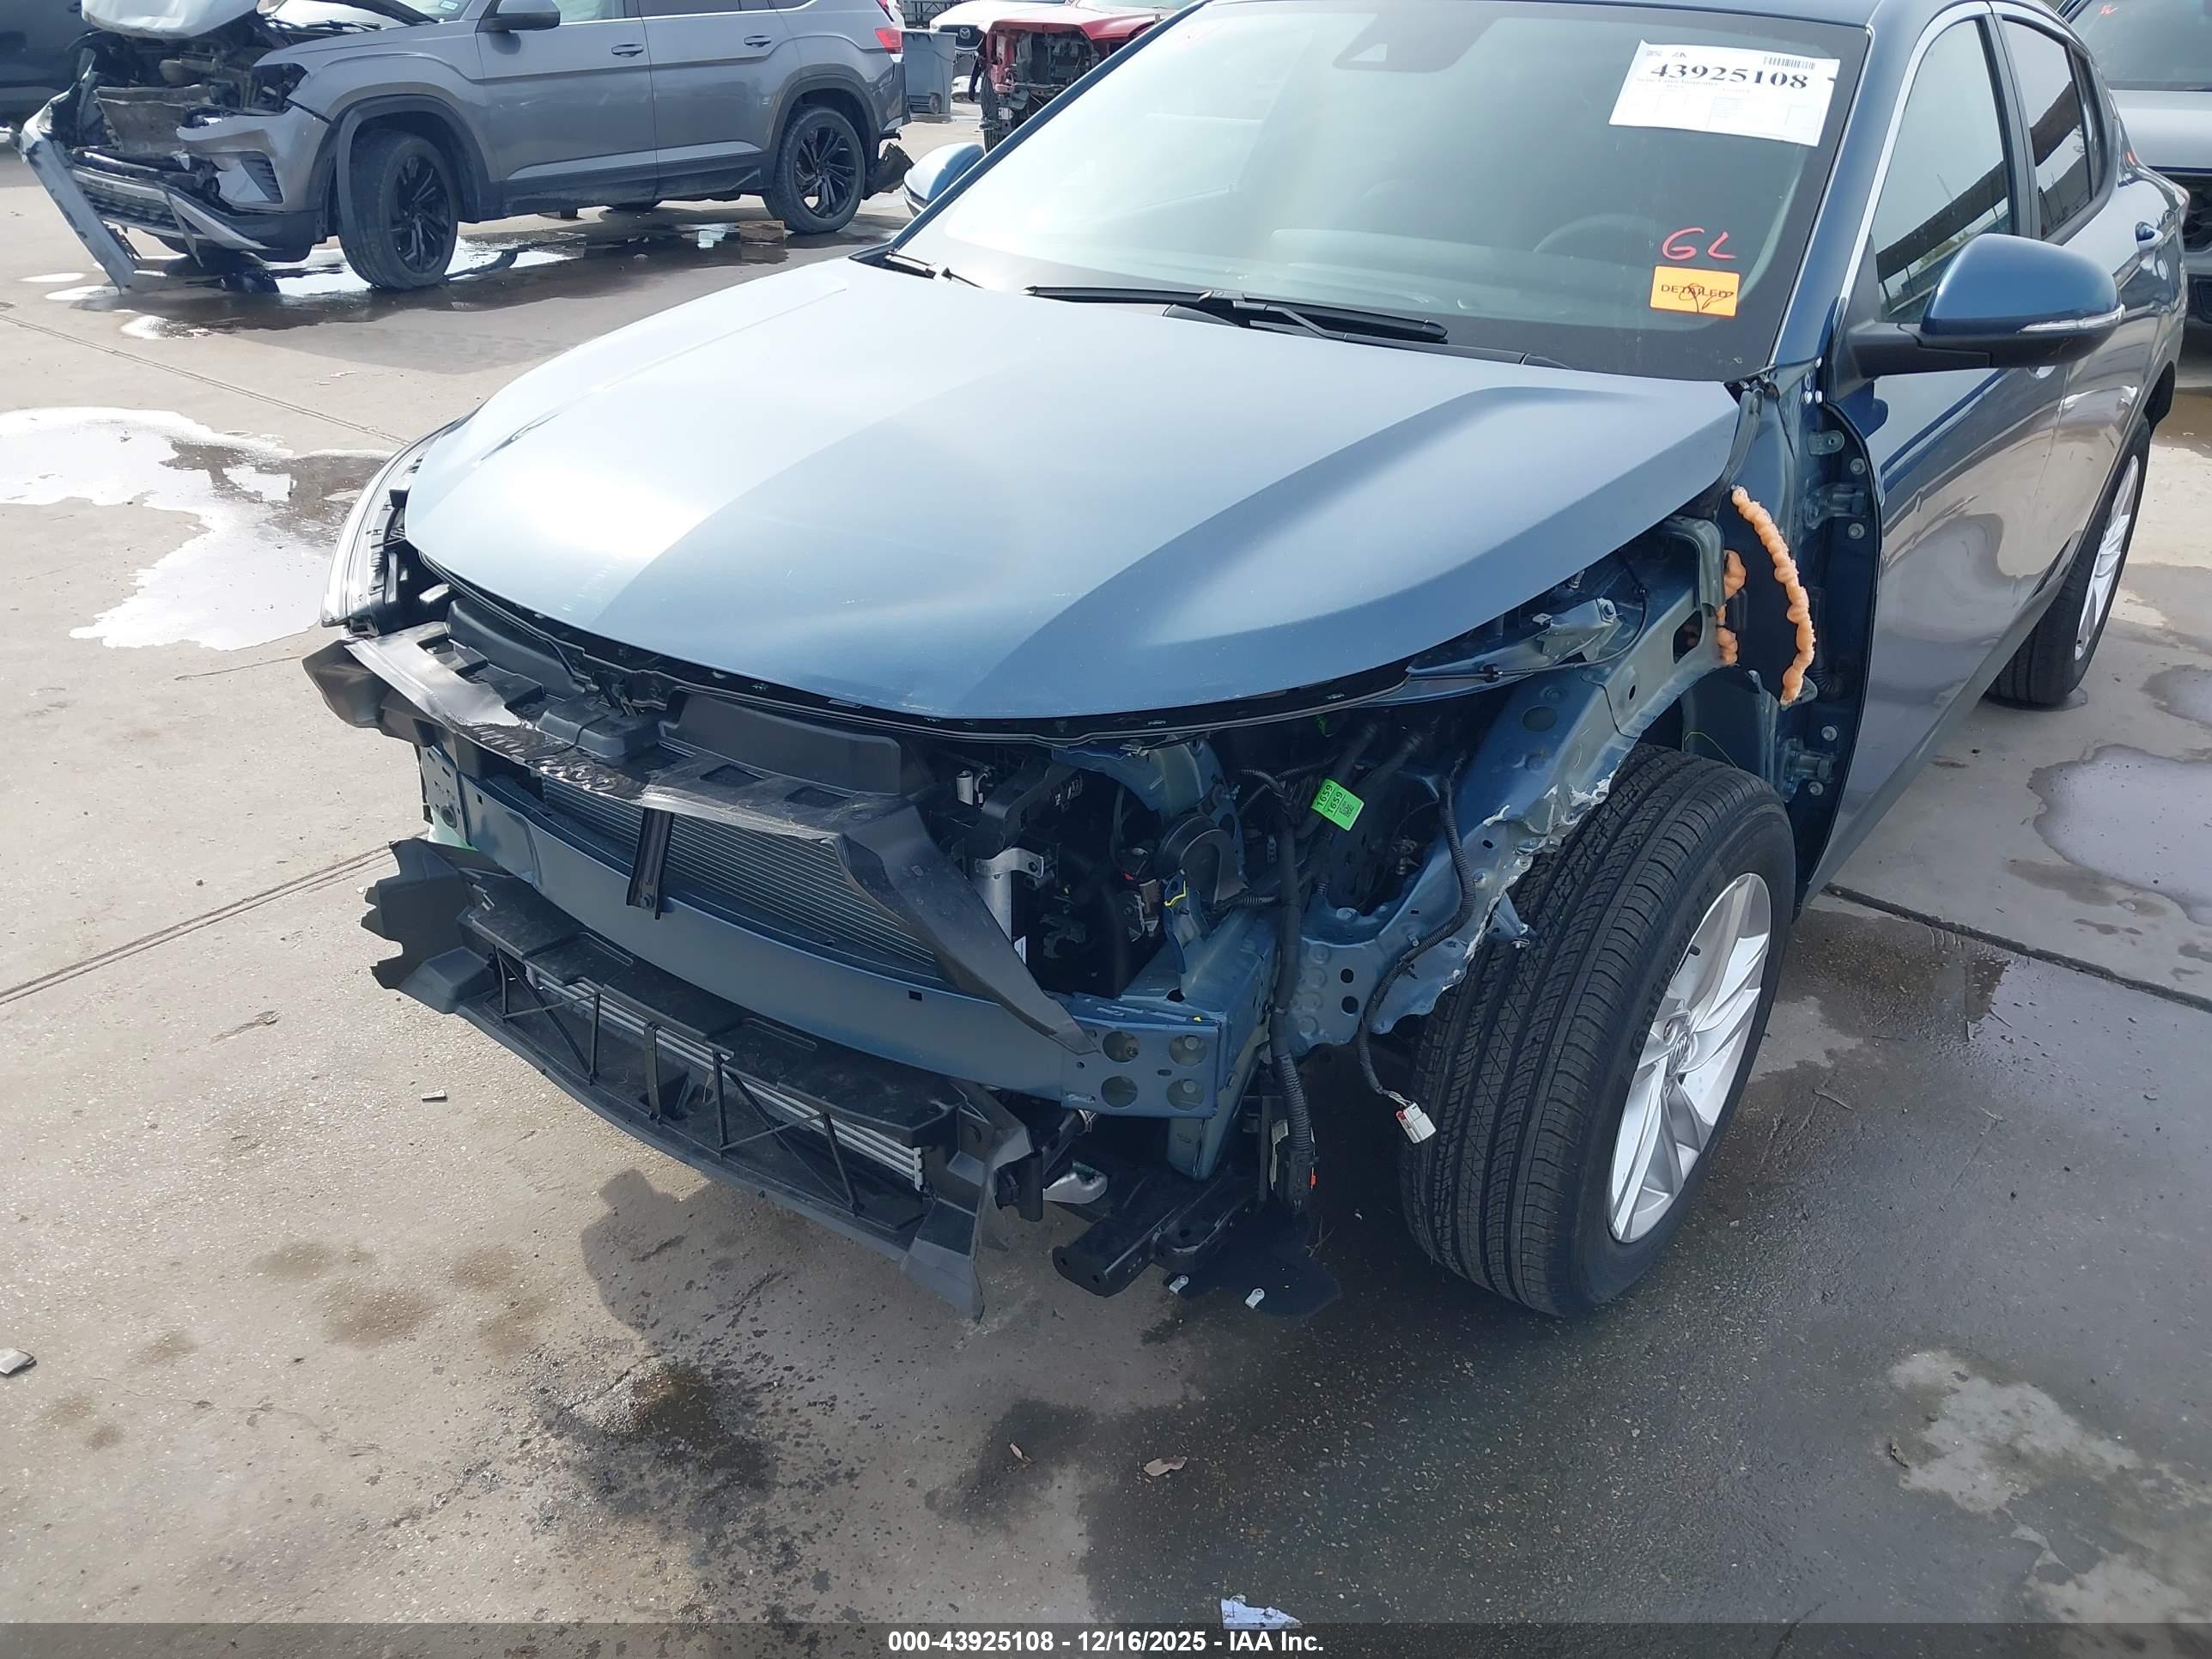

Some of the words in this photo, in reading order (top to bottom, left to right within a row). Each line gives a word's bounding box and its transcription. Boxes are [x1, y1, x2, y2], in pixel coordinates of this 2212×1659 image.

[1650, 64, 1808, 89] 43925108
[1660, 284, 1729, 299] DETAILED
[1316, 784, 1333, 808] 1659
[1327, 791, 1344, 814] 1659
